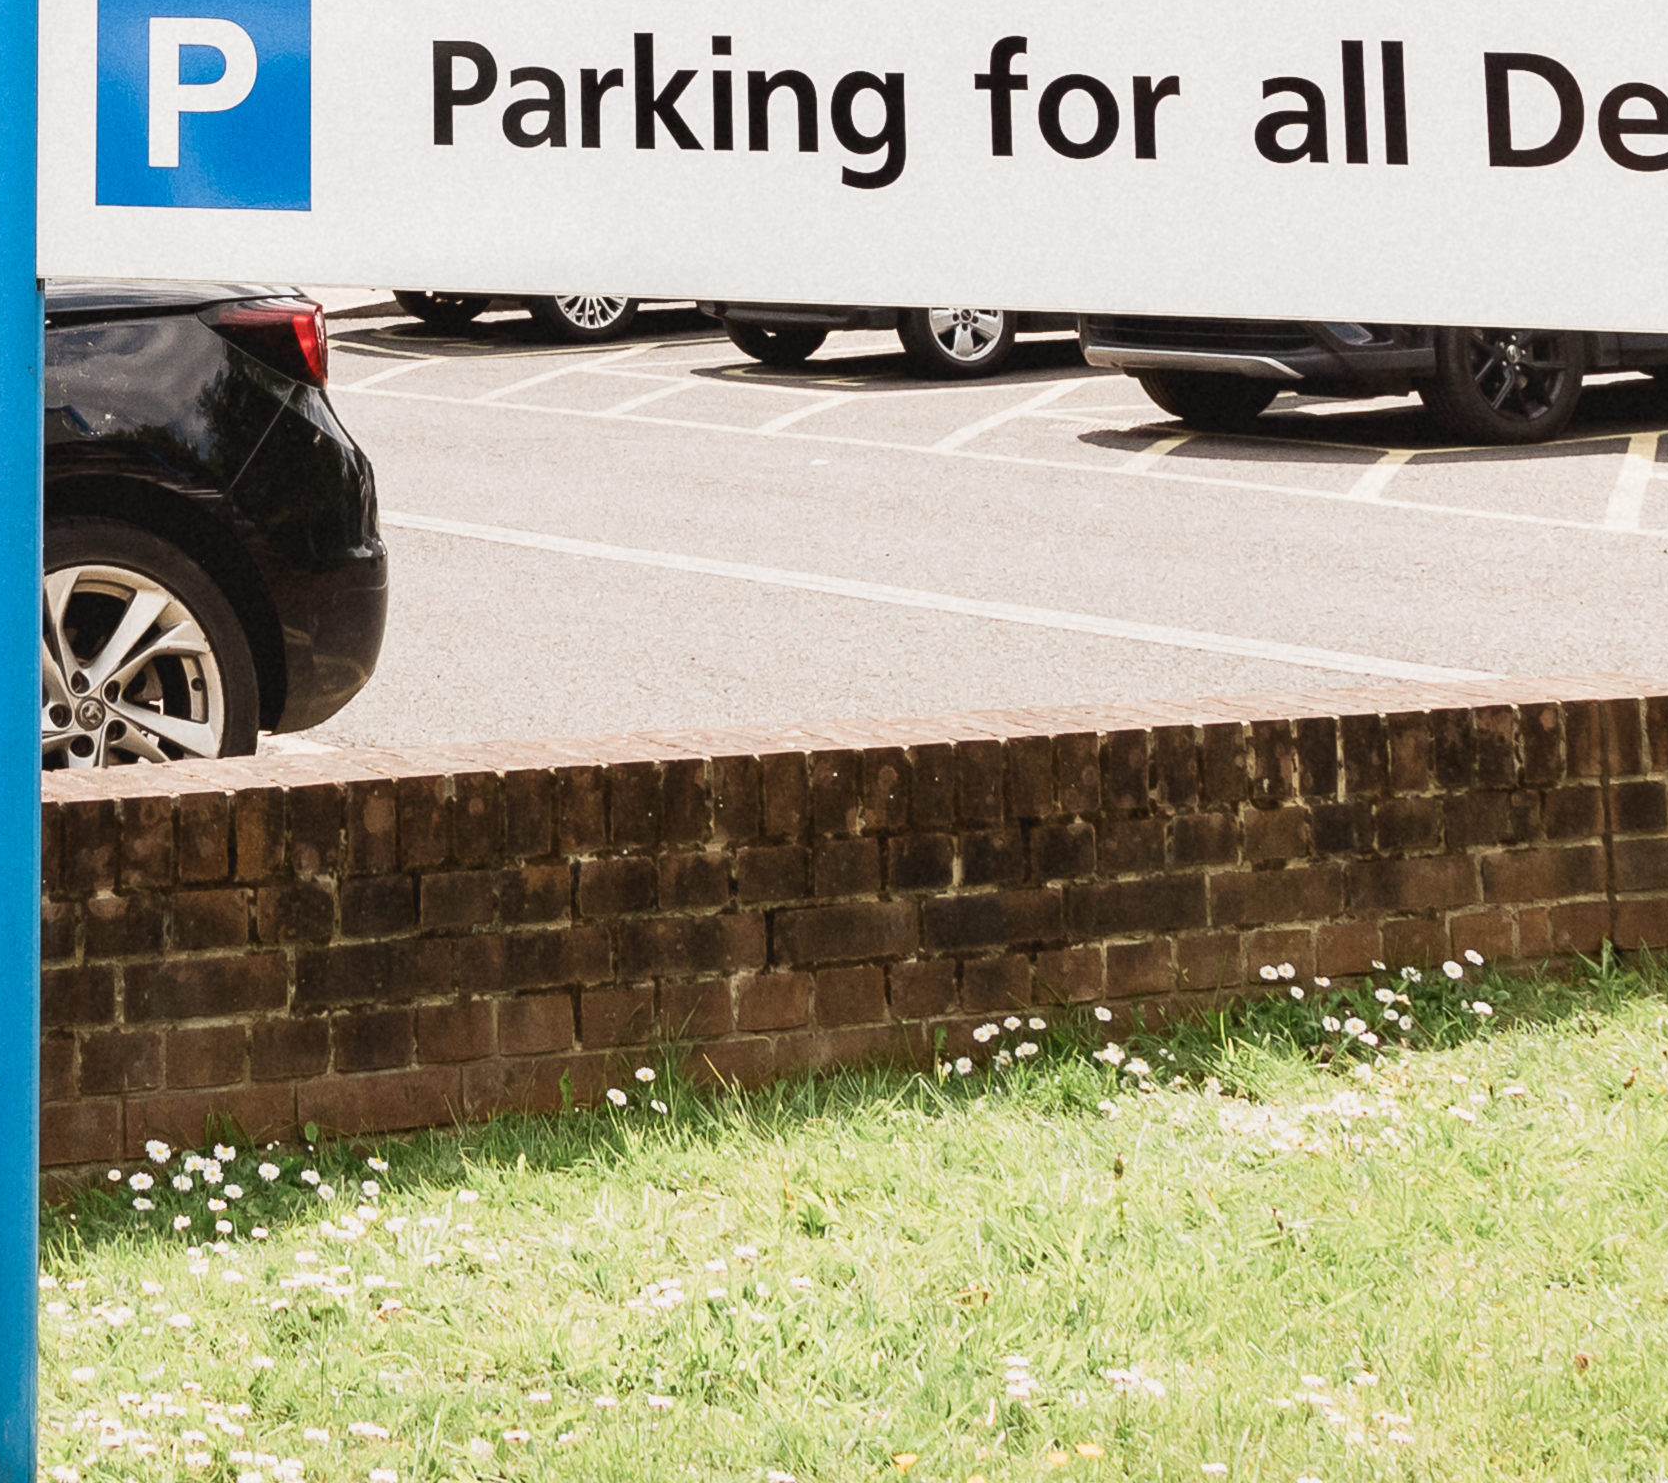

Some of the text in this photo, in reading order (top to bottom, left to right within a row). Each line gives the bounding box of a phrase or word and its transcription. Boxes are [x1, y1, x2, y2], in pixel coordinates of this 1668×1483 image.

[147, 15, 258, 169] P
[432, 32, 907, 190] Parking
[974, 35, 1181, 160] for
[1254, 40, 1409, 165] all
